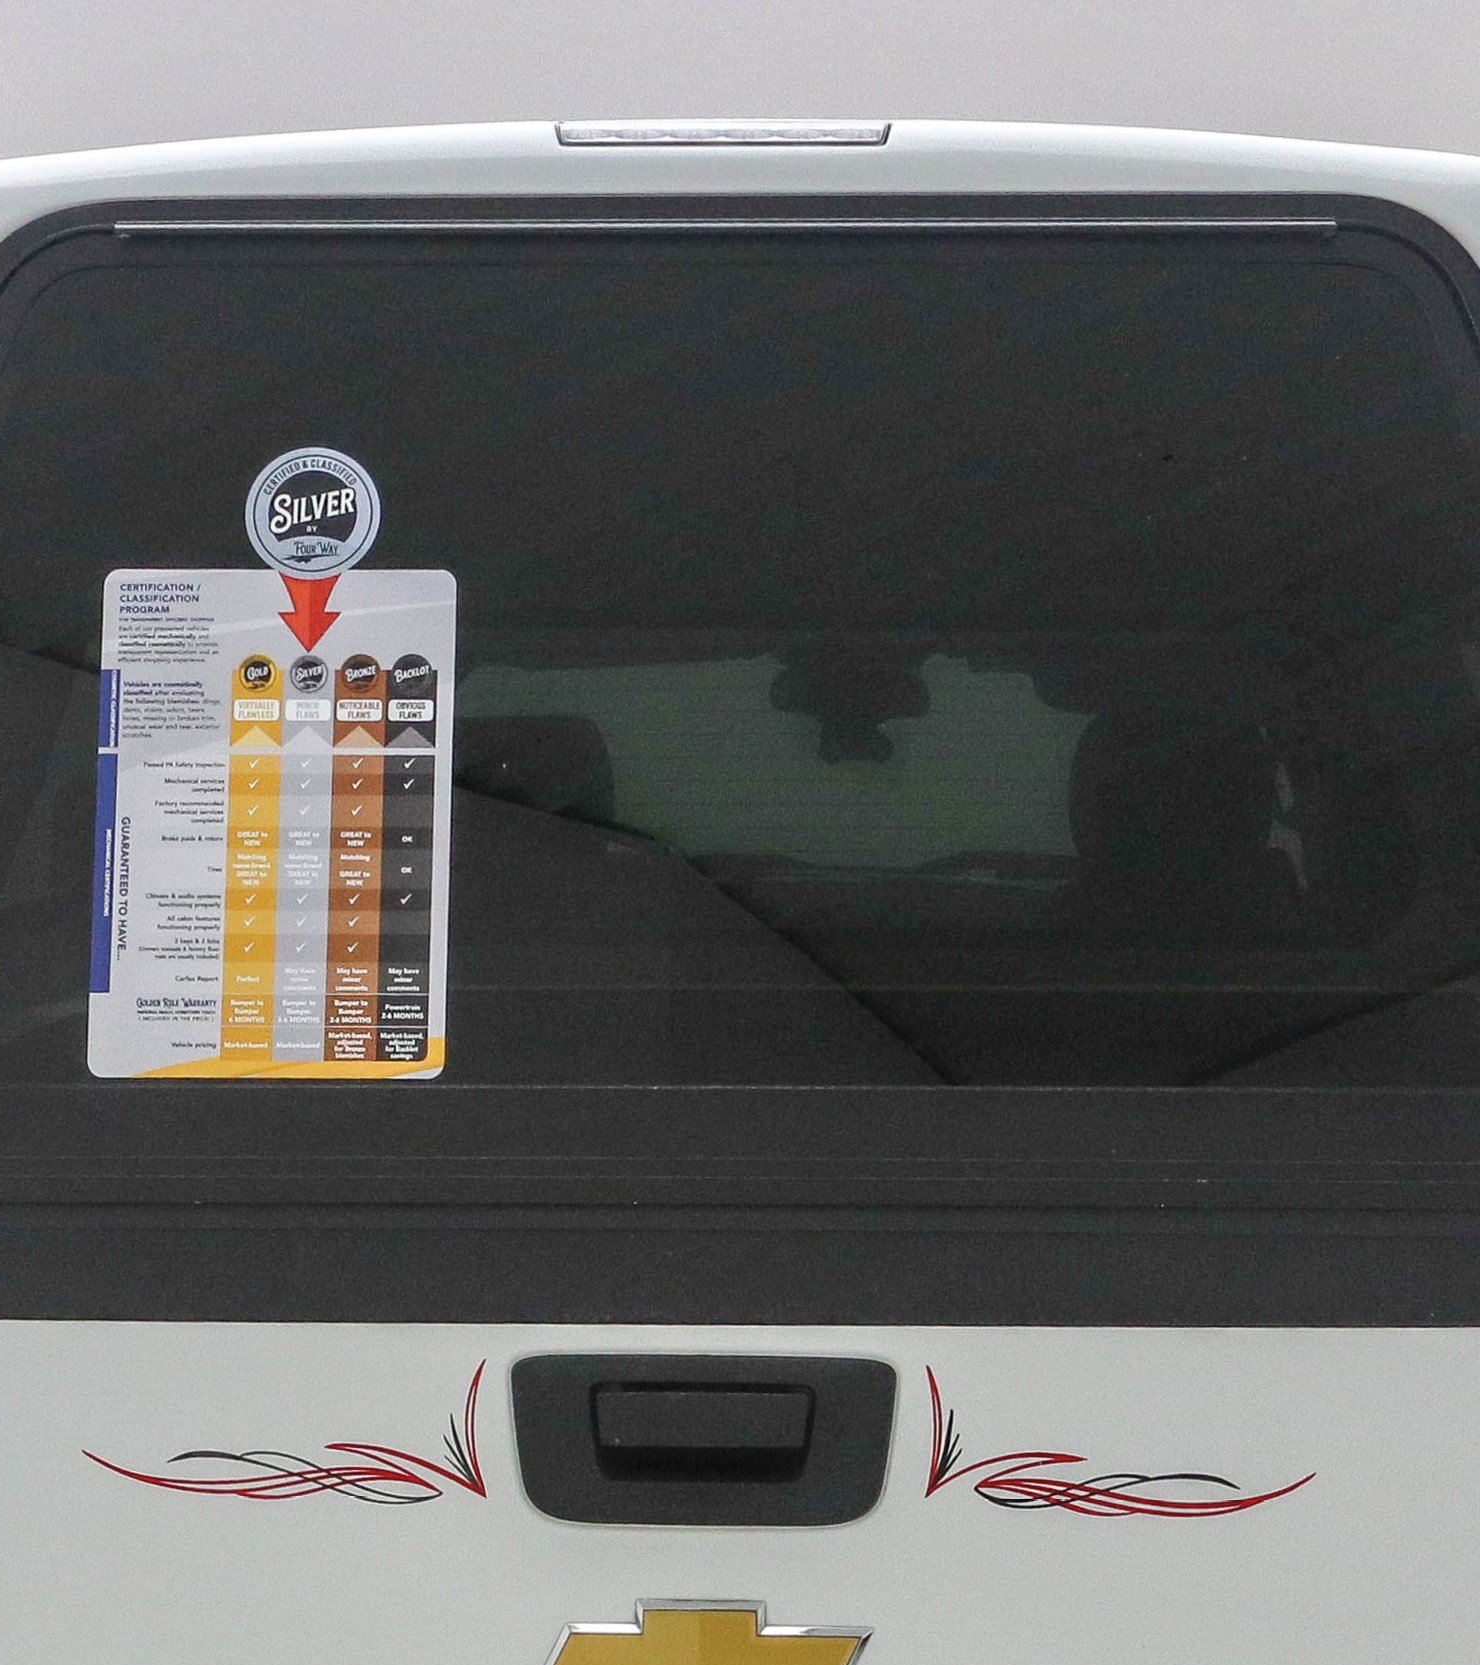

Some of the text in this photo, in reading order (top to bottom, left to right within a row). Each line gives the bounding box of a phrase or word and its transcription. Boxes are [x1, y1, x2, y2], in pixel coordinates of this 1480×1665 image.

[263, 459, 357, 495] CERTIFIED & CLASSIFIED
[270, 488, 355, 534] SILVER
[293, 541, 339, 555] FOUR WAY
[120, 583, 194, 592] CERTIFICATION
[120, 594, 200, 603] CLASSIFICATION
[119, 606, 170, 614] PROGRAM
[246, 667, 269, 680] GOLD
[296, 665, 323, 681] SILVER
[345, 665, 377, 683] BRONZE
[394, 665, 431, 683] BACKLOT
[339, 702, 380, 710] NOTICEABLE
[238, 711, 274, 719] FLAWLESS
[348, 711, 370, 719] FLAWS
[399, 711, 423, 719] FLAWS
[118, 817, 131, 897] GUARANTEED
[117, 900, 129, 916] TO
